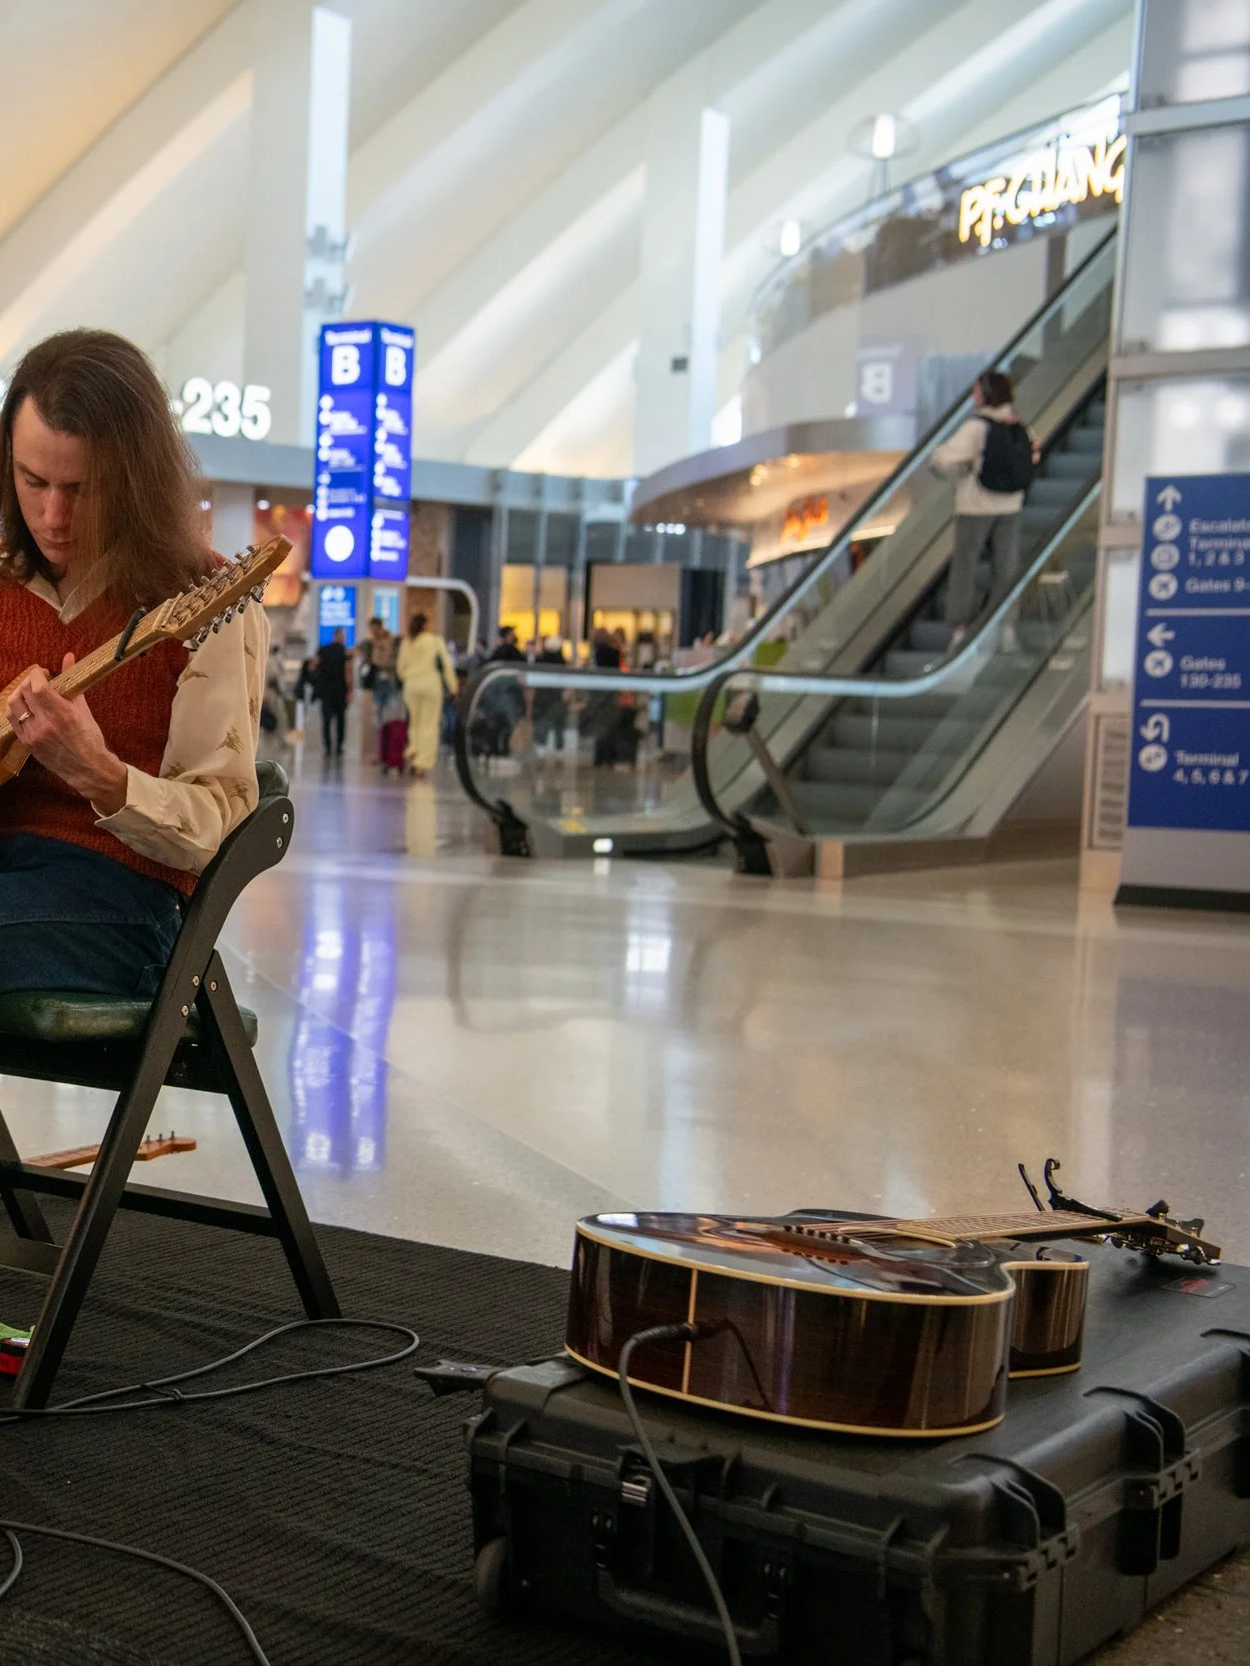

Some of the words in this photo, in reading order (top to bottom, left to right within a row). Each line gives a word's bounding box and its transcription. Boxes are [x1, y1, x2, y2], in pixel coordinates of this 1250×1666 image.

[331, 344, 361, 385] B
[385, 344, 406, 387] B
[1185, 576, 1231, 594] Gates
[1179, 655, 1226, 671] Gates
[1175, 750, 1239, 767] Terminal
[1238, 769, 1249, 785] 7
